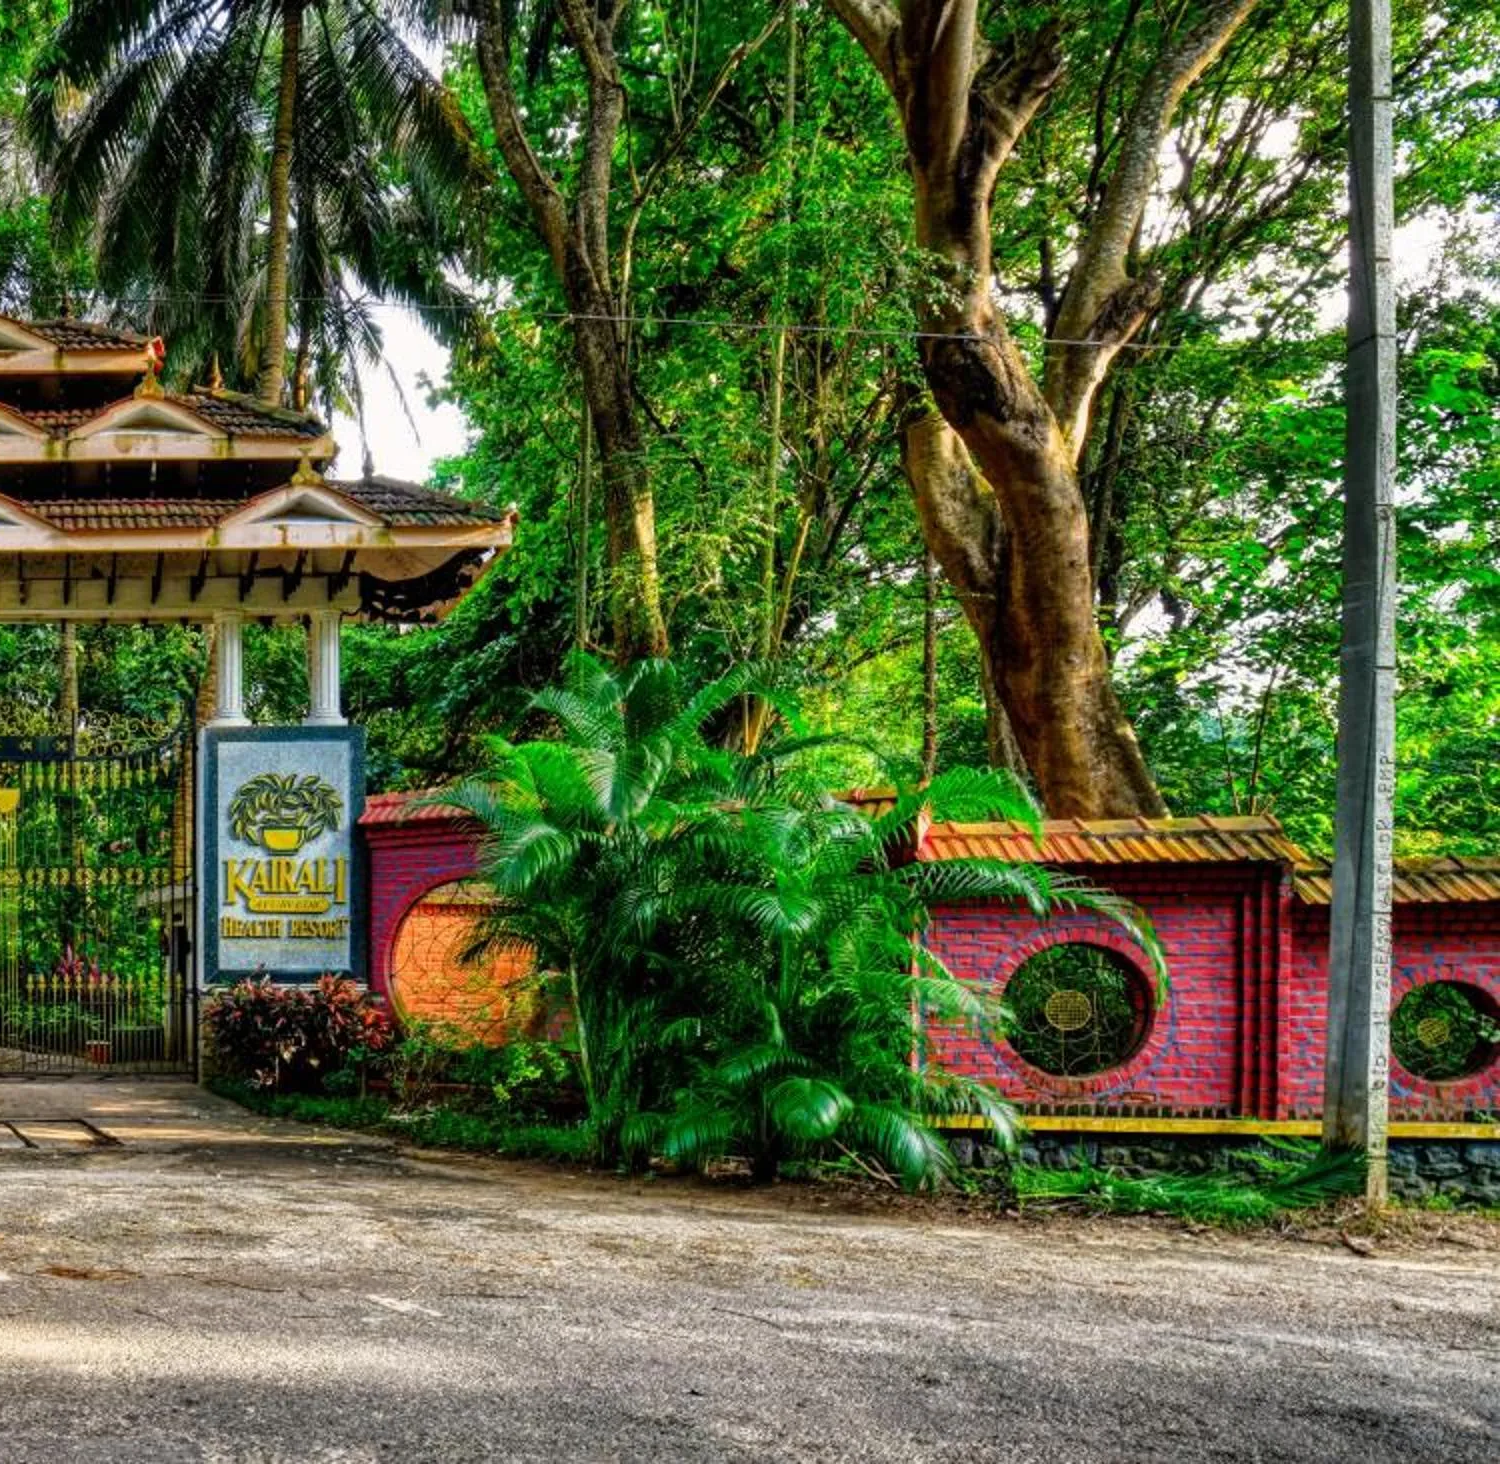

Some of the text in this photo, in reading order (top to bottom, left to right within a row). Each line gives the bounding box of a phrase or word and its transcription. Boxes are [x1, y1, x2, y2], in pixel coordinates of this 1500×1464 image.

[222, 857, 348, 905] KAIRALI
[220, 915, 349, 939] HEALTH RESORT
